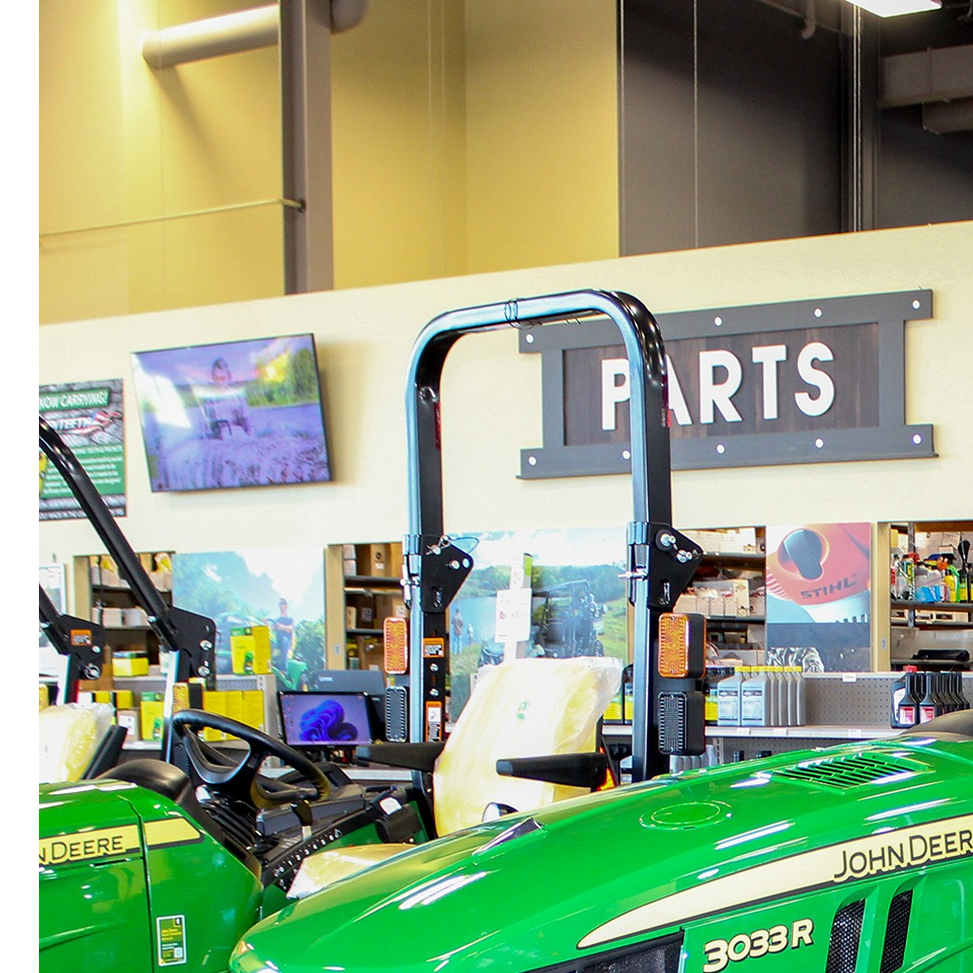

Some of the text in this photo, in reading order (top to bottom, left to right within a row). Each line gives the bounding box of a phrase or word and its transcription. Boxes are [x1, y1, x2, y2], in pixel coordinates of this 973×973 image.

[800, 576, 857, 598] STIHL
[51, 836, 124, 860] DEERE
[833, 842, 905, 880] JOHN
